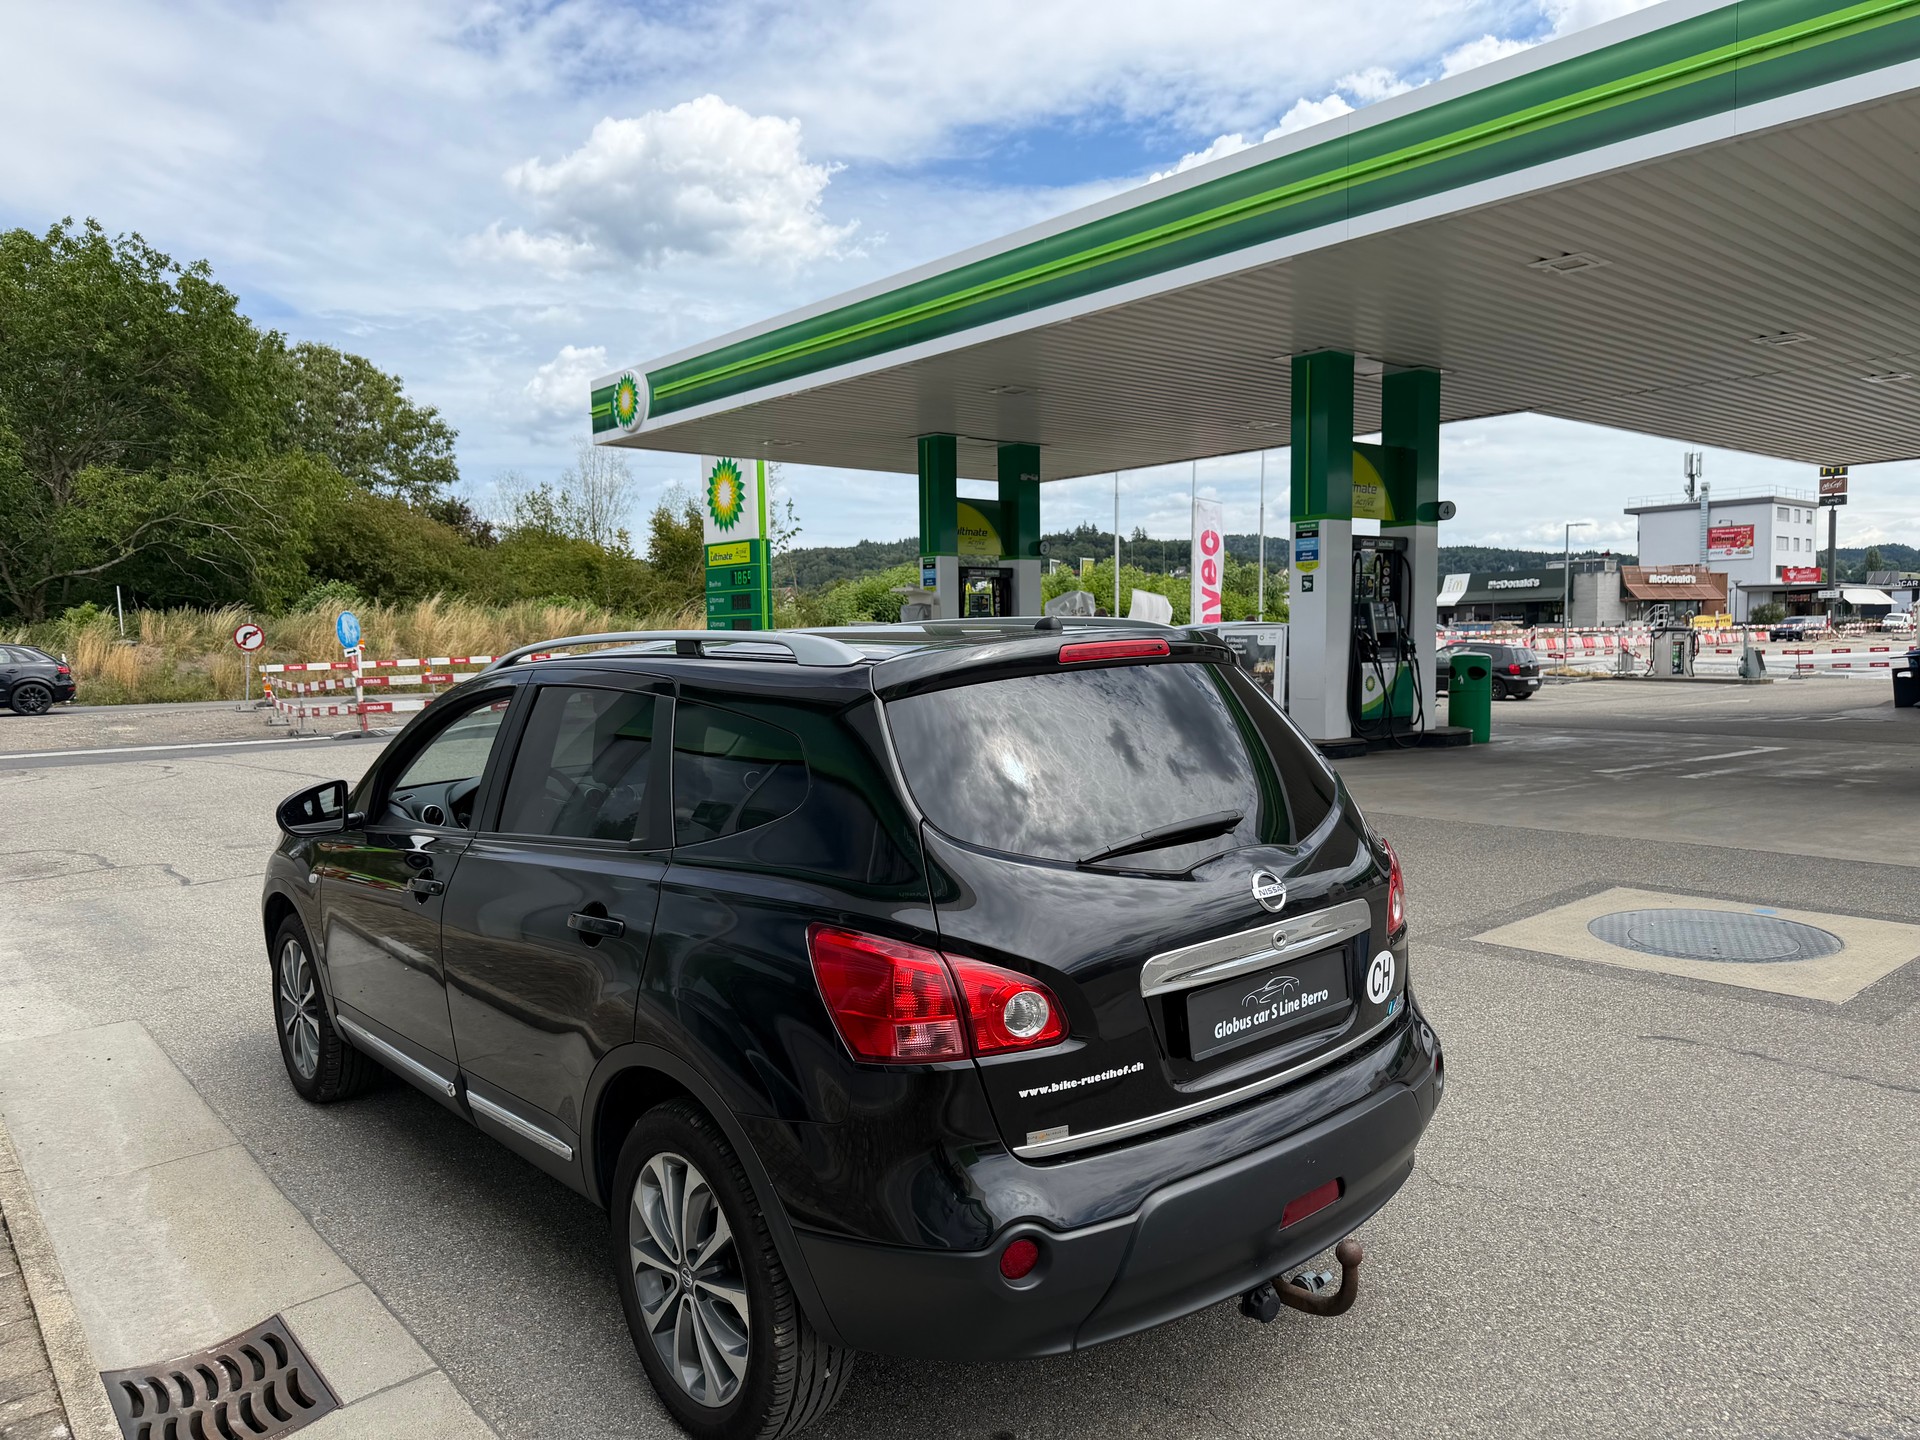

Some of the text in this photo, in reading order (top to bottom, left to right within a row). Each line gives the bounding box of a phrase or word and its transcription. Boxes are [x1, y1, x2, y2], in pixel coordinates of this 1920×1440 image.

[1443, 505, 1449, 515] 4
[1042, 543, 1047, 552] 2
[1648, 574, 1697, 584] McDonald's
[1259, 884, 1286, 896] NISSAN
[1372, 957, 1391, 997] CH
[1214, 989, 1329, 1039] Globus car S Line Berro
[1018, 1061, 1145, 1099] www.bike-ruetihof.ch
